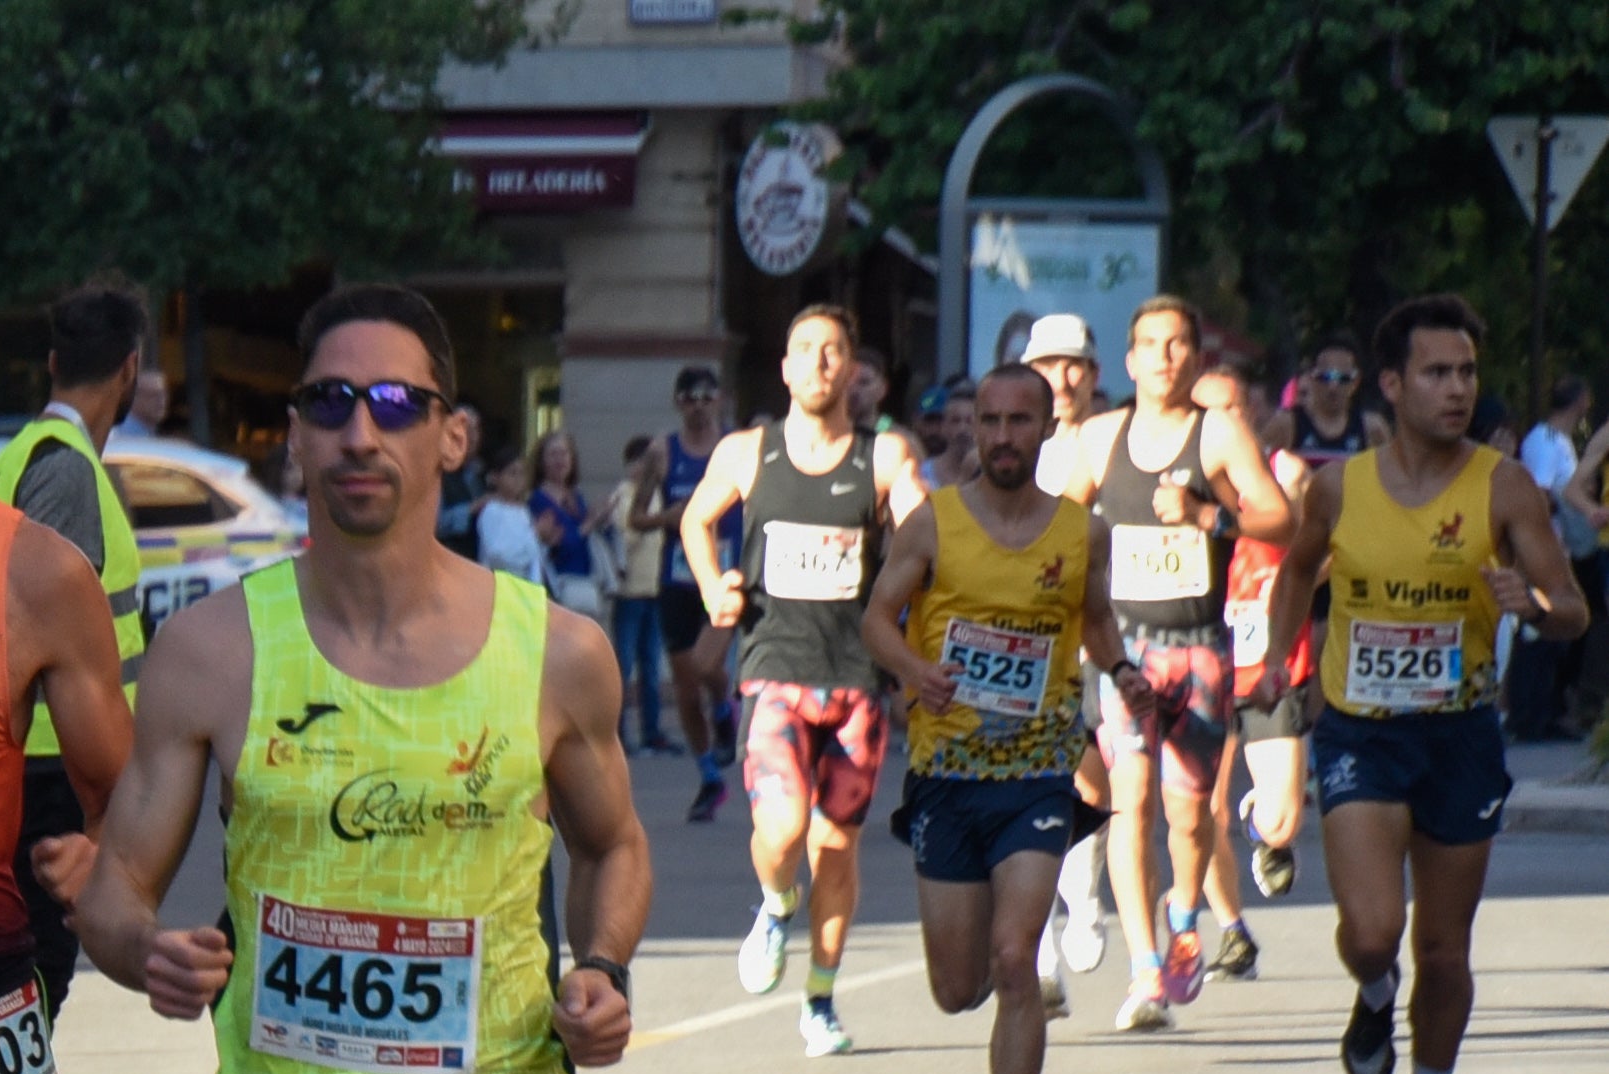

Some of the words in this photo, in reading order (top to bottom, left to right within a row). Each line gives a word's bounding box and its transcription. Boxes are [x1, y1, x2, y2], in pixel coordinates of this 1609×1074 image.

[1385, 580, 1471, 606] Vigilsa
[948, 646, 1035, 690] 5525
[1355, 648, 1442, 678] 5526
[267, 902, 294, 938] 40
[264, 947, 443, 1023] 4465
